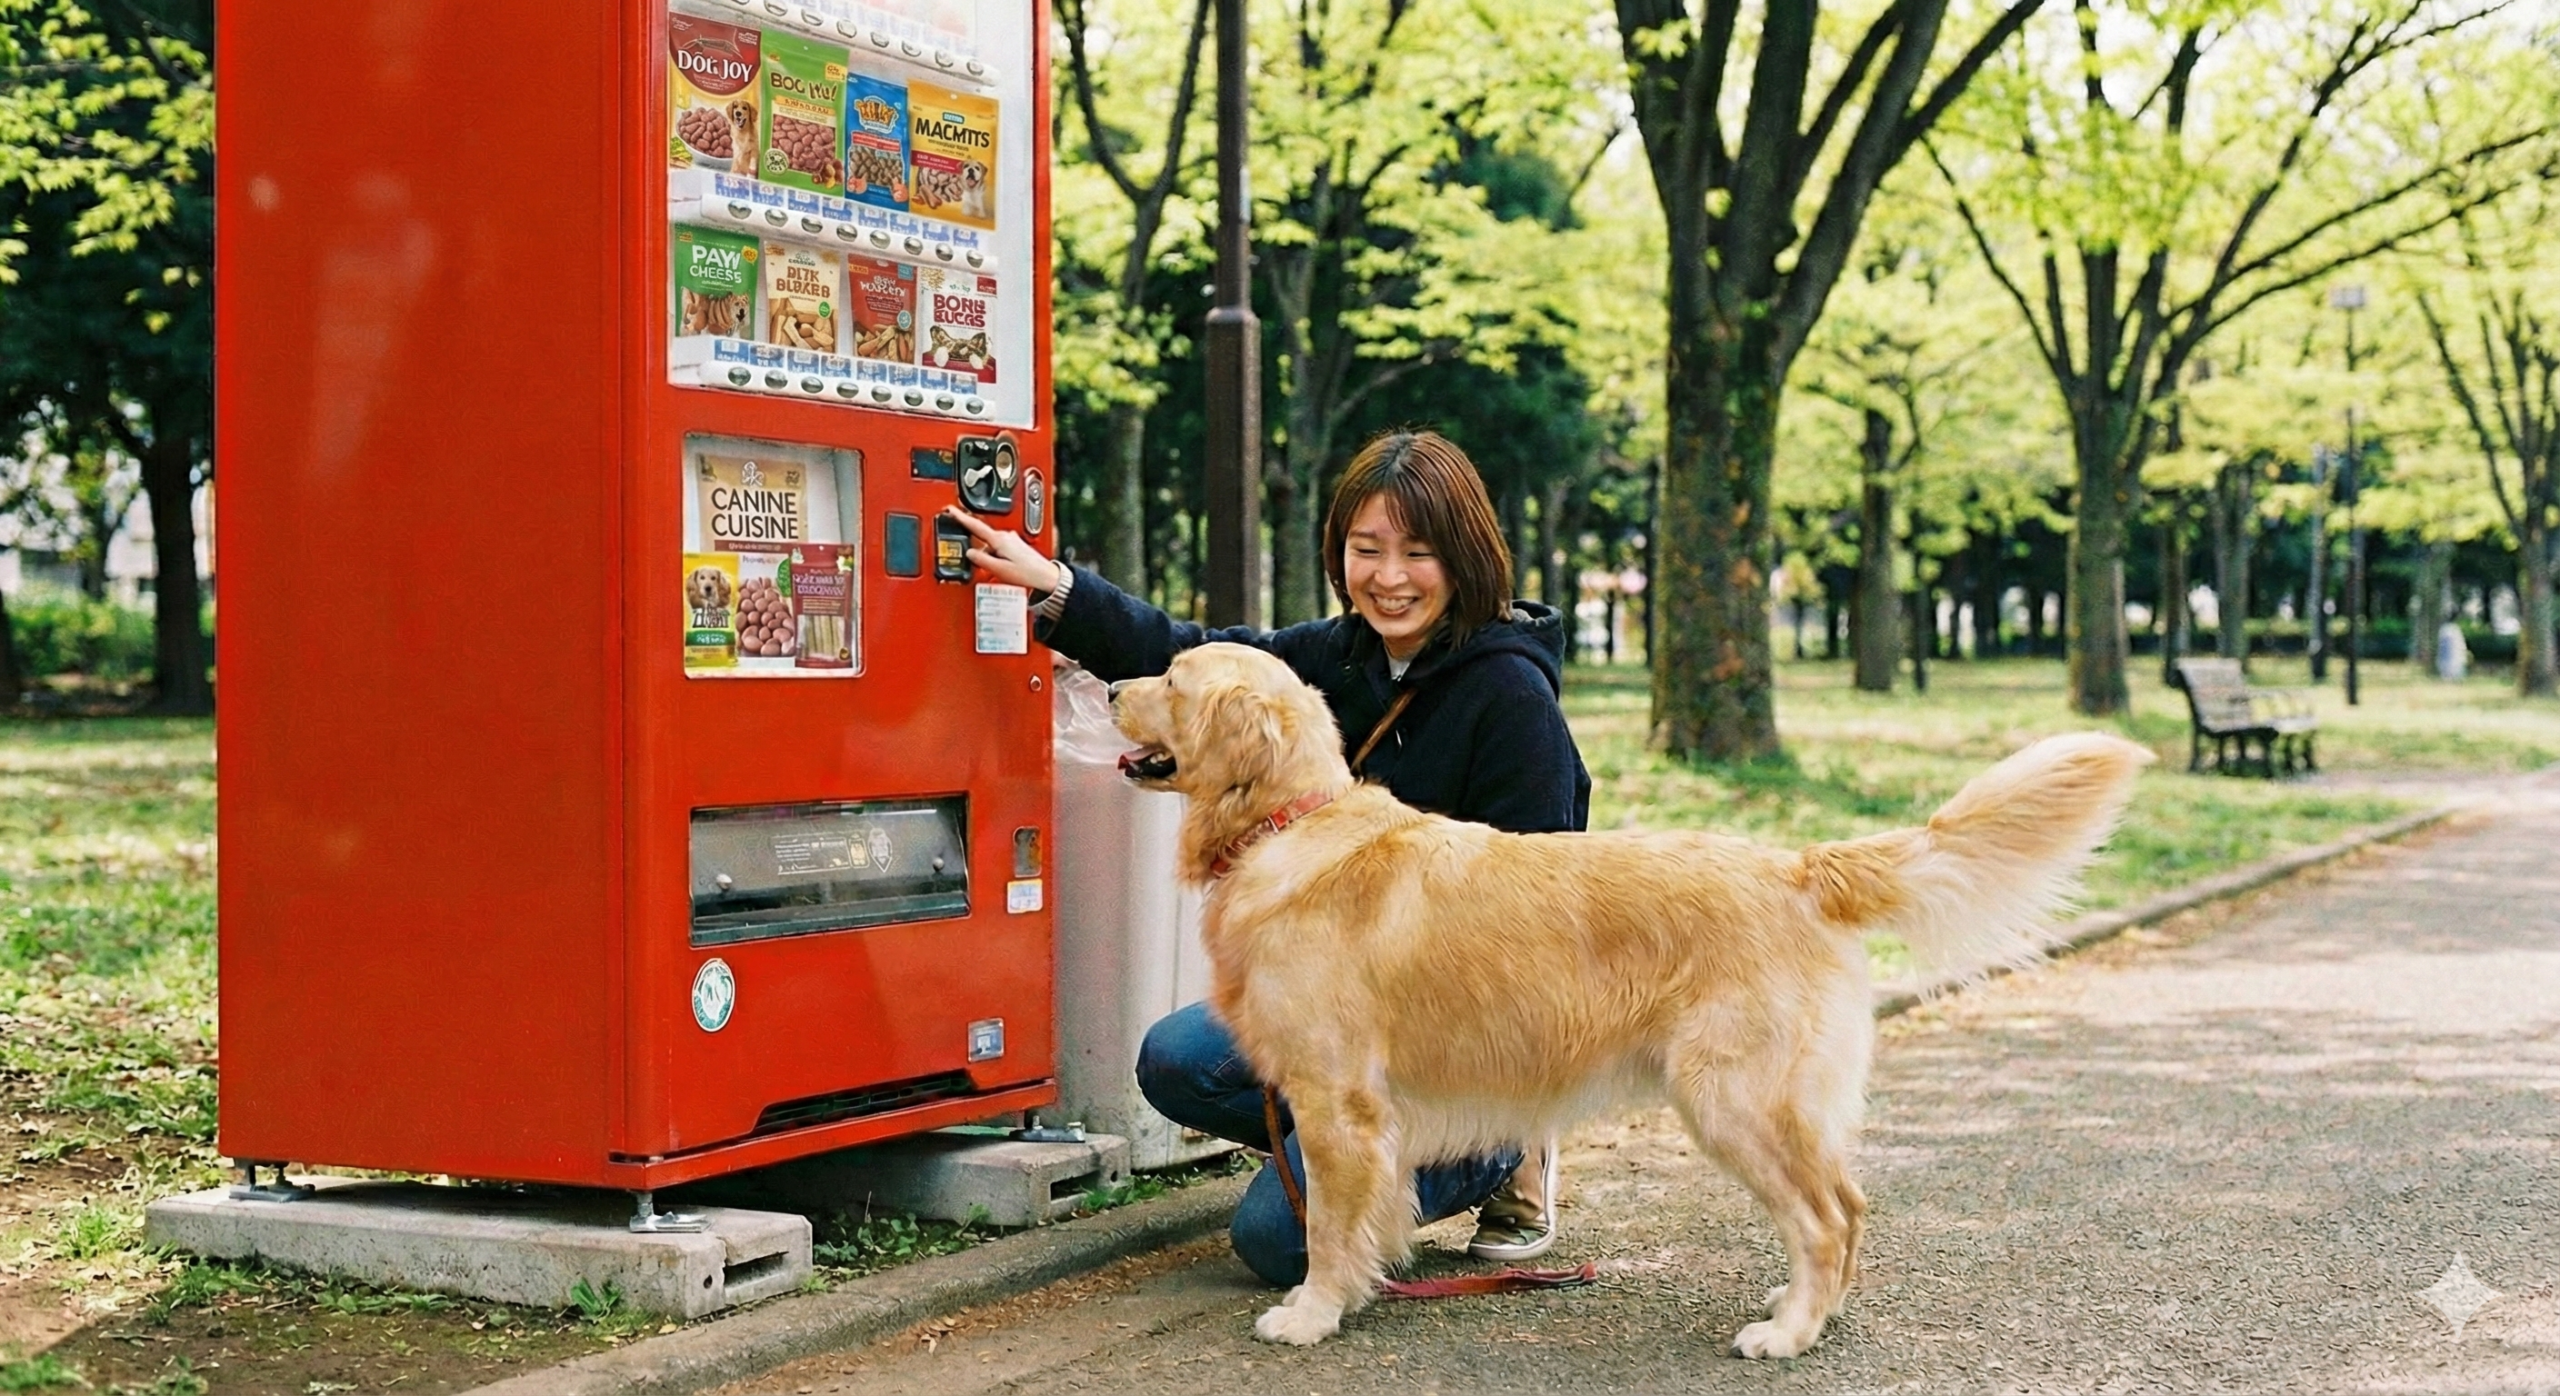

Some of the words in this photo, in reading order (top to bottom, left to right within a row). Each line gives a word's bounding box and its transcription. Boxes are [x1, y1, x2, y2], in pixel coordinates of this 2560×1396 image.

[719, 59, 753, 82] JOY
[711, 487, 798, 514] CANINE
[711, 513, 799, 540] CUISINE
